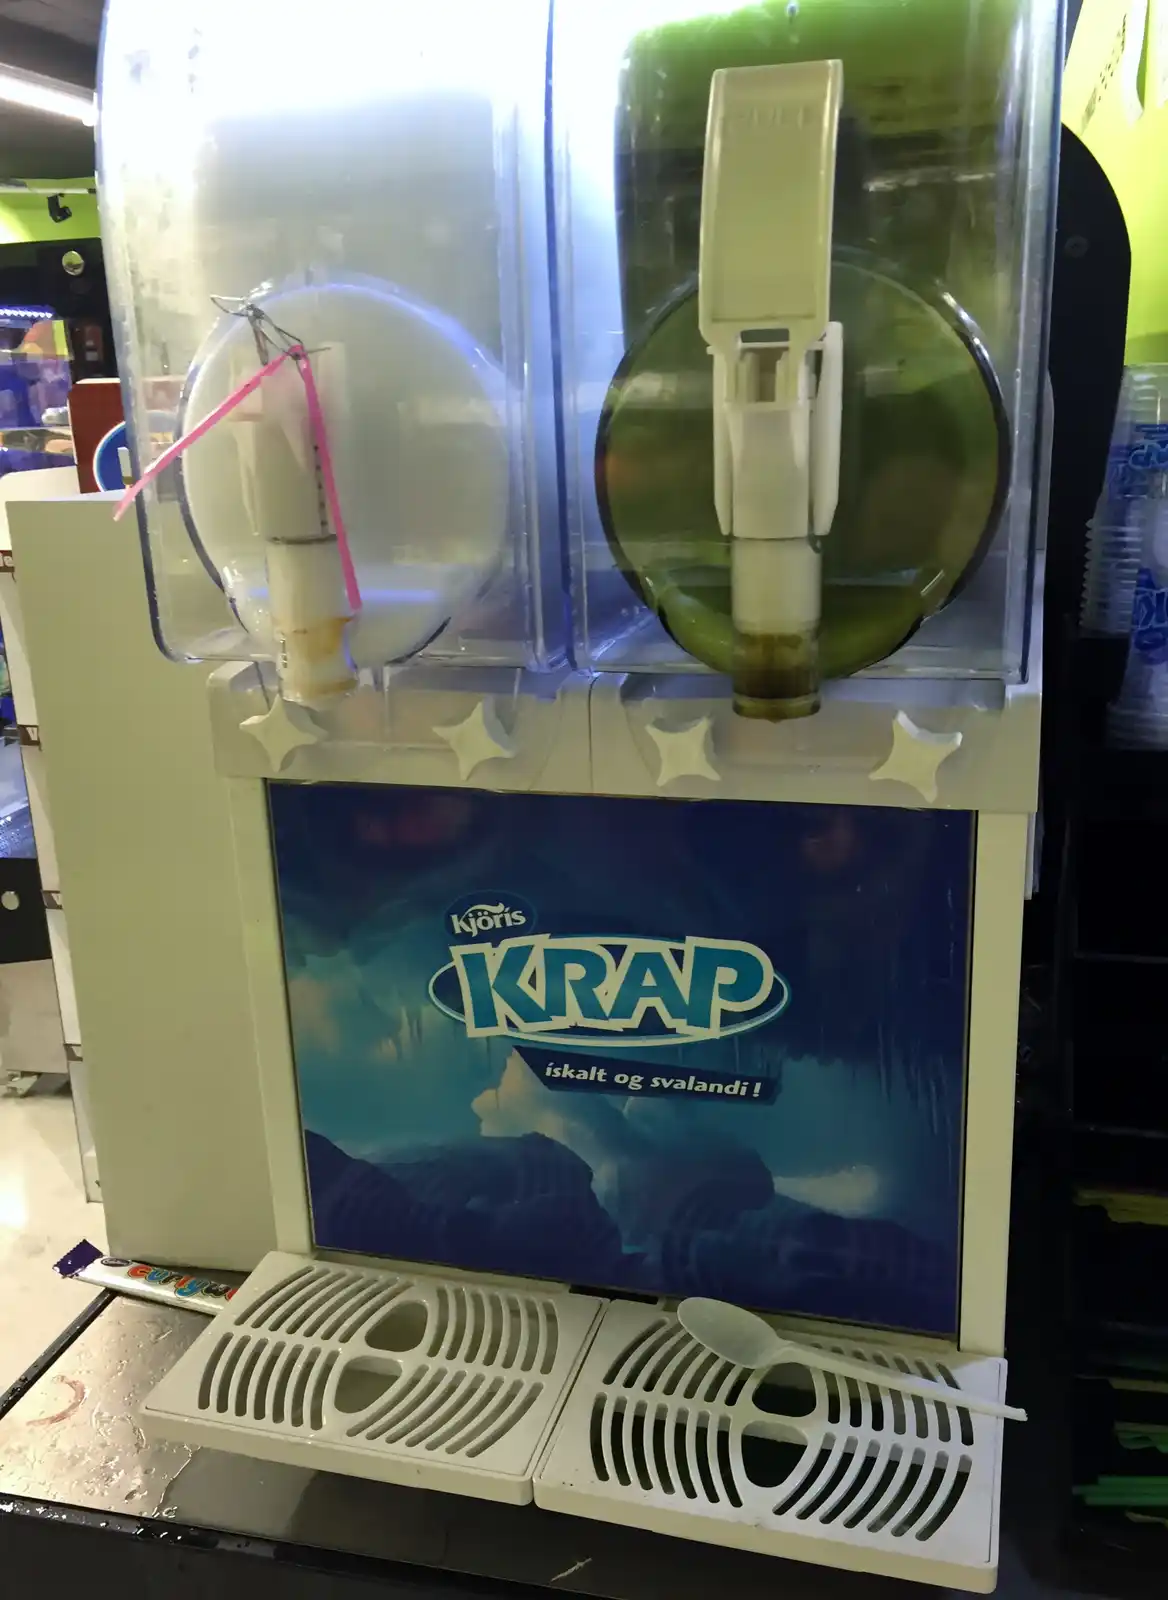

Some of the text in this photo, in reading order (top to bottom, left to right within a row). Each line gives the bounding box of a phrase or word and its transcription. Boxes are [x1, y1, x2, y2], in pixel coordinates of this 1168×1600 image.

[449, 933, 774, 1039] KRAP
[545, 1062, 607, 1083] ískalt
[614, 1073, 644, 1090] og
[650, 1076, 749, 1097] svalandi
